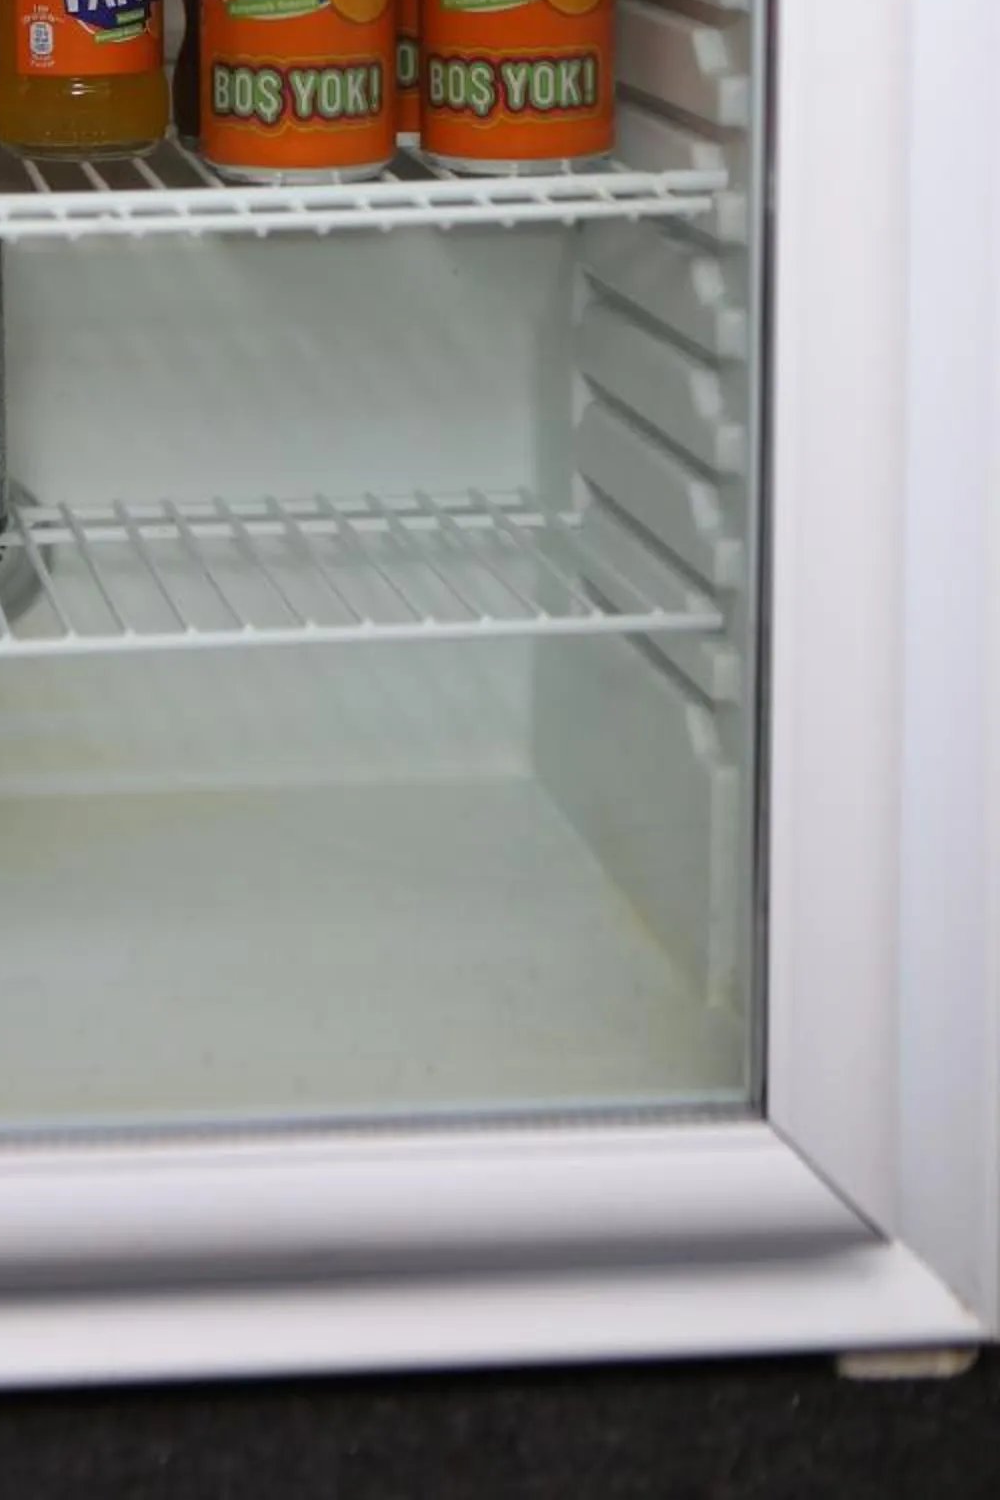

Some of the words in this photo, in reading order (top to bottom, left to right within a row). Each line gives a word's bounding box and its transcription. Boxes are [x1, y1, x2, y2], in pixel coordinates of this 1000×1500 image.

[214, 65, 283, 123] BOŞ
[288, 62, 380, 118] YOK!
[430, 58, 495, 117] BOŞ
[501, 57, 595, 111] YOK!
